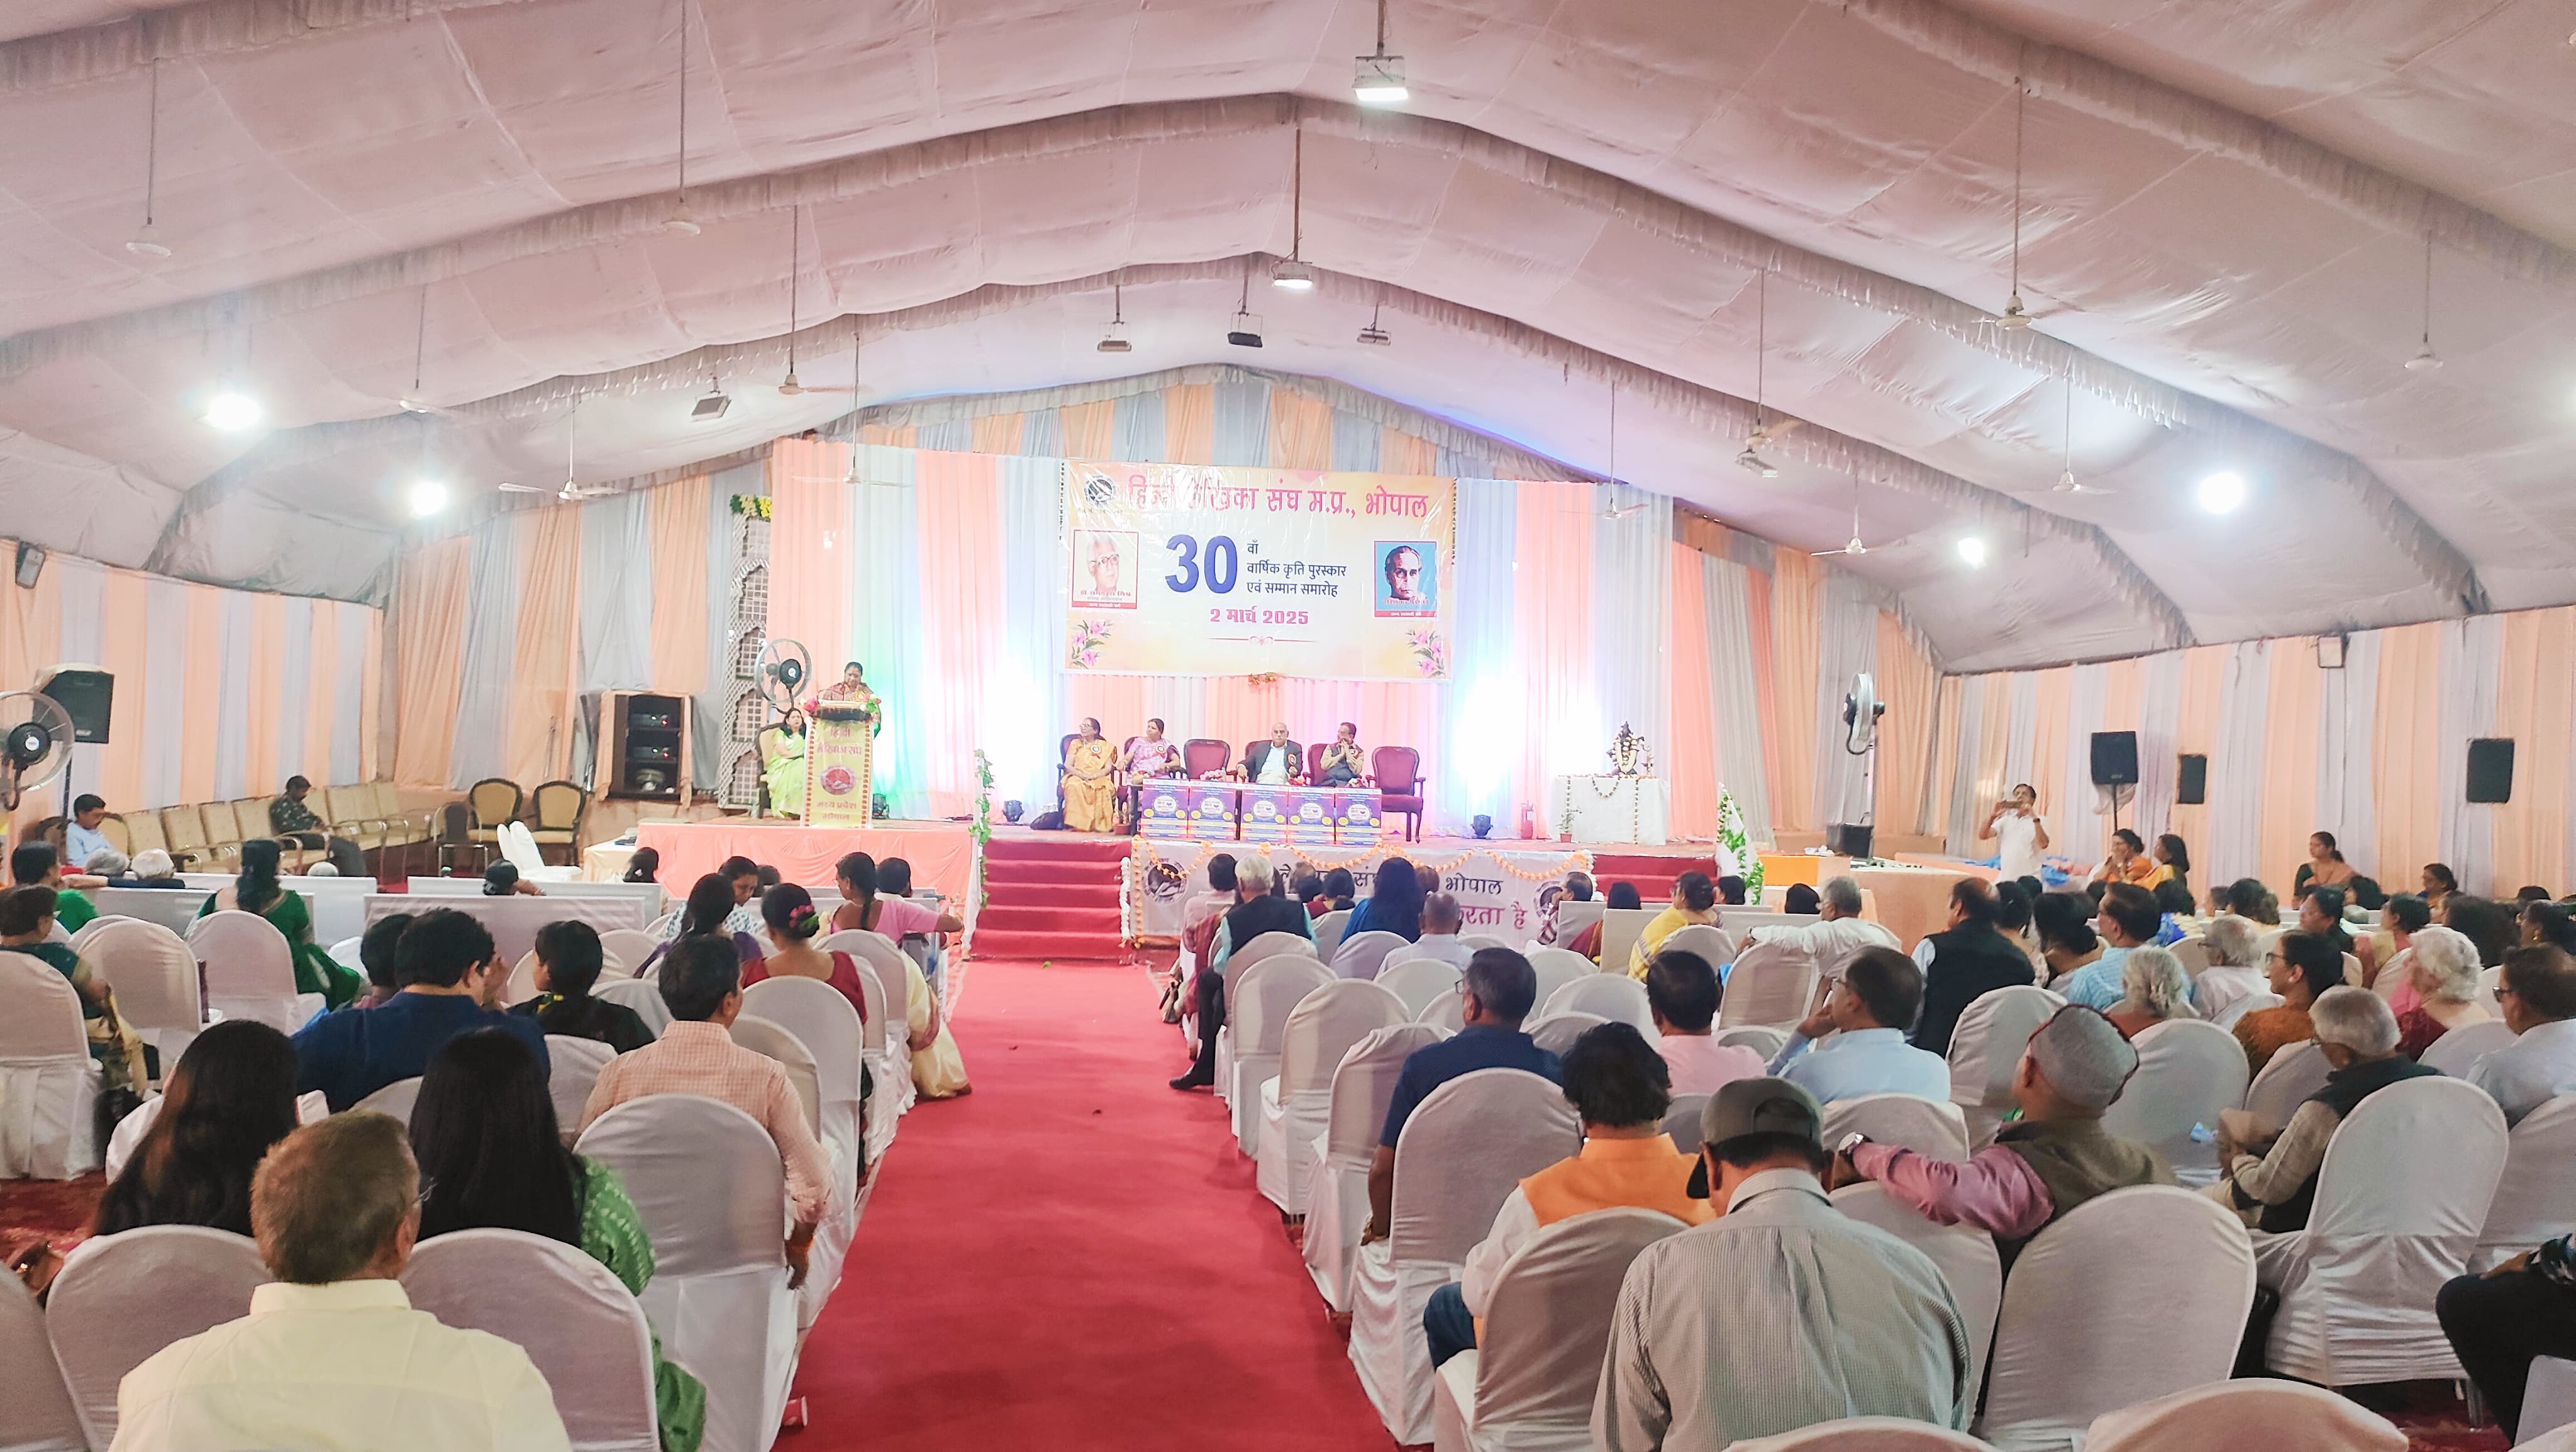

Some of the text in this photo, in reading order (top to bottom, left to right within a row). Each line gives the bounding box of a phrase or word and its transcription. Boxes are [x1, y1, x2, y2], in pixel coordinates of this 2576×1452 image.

[1265, 478, 1302, 512] संघ
[1365, 484, 1429, 518] भोपाल
[1165, 534, 1238, 594] 30
[1246, 559, 1347, 579] वार्षिक कृति पुरस्कार
[1246, 579, 1339, 597] एवं सम्मान समारोह
[1210, 606, 1309, 625] 2 मार्च 2025
[1353, 866, 1377, 886] सं
[1445, 873, 1504, 895] भोपाल
[1511, 901, 1528, 929] है
